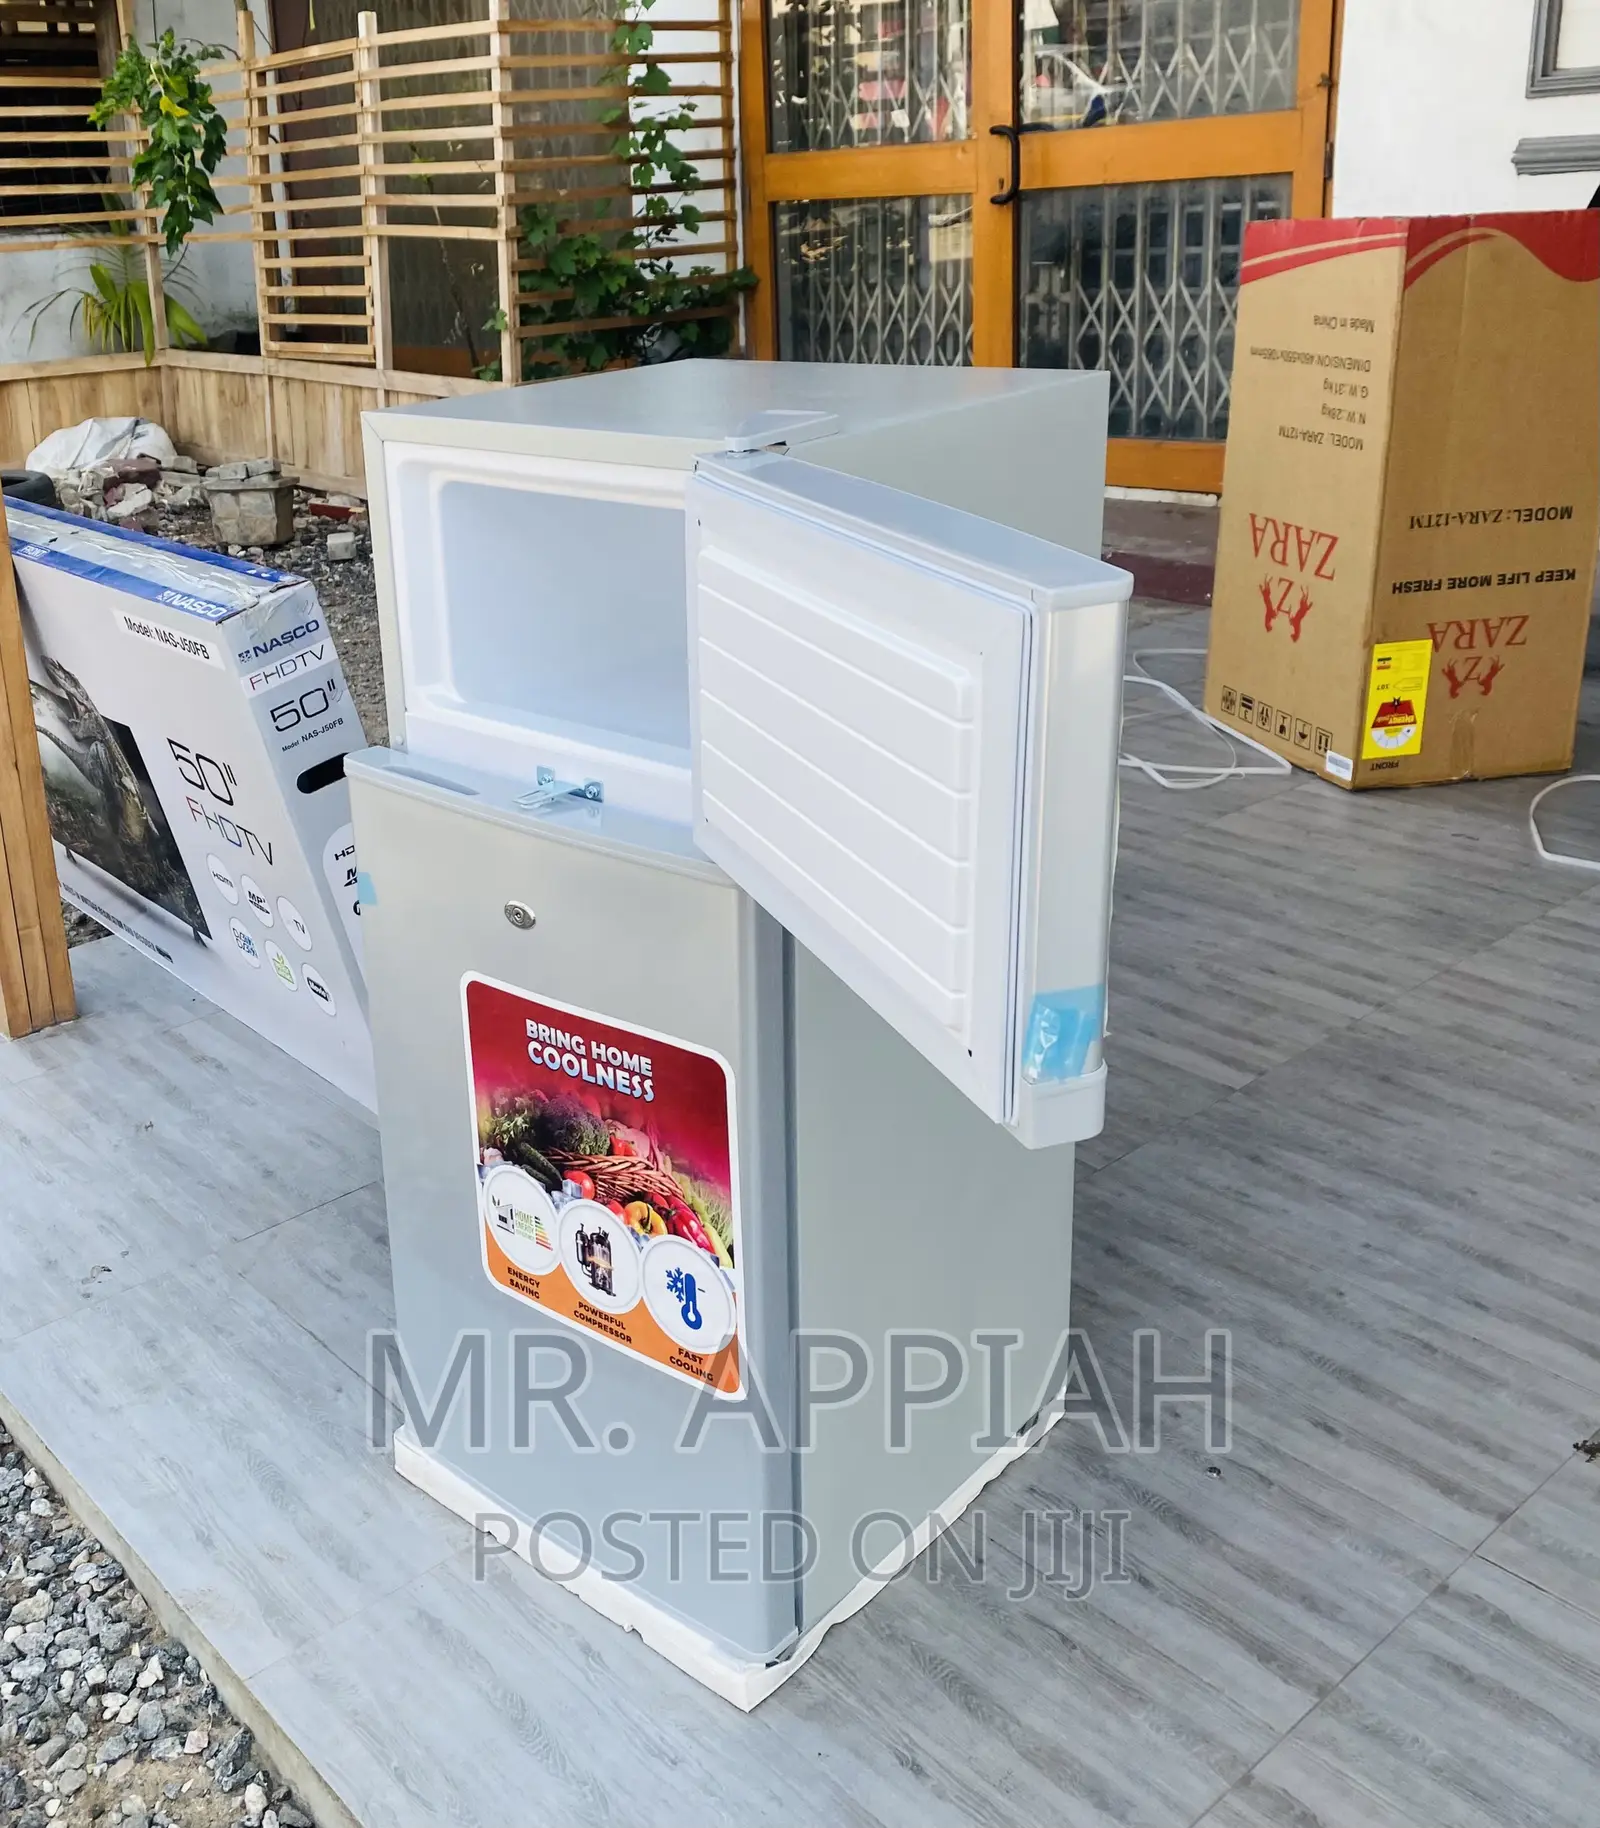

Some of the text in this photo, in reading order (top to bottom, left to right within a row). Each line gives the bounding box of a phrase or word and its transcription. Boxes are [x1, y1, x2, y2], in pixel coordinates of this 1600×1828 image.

[1313, 315, 1337, 330] China
[1350, 317, 1375, 333] Made
[1278, 425, 1324, 445] ZARA-12TM
[1409, 509, 1503, 530] ZARA-12TM
[1249, 512, 1339, 581] ZARA
[1391, 568, 1576, 594] KEEP LIFE MORE FRESH
[169, 593, 228, 618] NASCO
[124, 616, 210, 660] Model: NAS-J50FB
[253, 619, 320, 657] NASCO
[1426, 614, 1530, 653] ZARA
[249, 644, 324, 691] FHDTV
[270, 678, 336, 732] 50"
[282, 717, 344, 752] Model NAS-J50FB
[166, 737, 238, 806] 50"
[1370, 760, 1400, 771] FRONT
[186, 795, 273, 866] FHDTV
[525, 1018, 653, 1077] BRING HOME
[527, 1040, 655, 1102] COOLNESS
[507, 1266, 540, 1288] ENERGY
[509, 1278, 540, 1299] SAVING
[573, 1310, 632, 1344] COMPRESSOR
[578, 1301, 626, 1331] POWERFUL
[669, 1355, 714, 1382] COOLING
[678, 1347, 704, 1365] FAST
